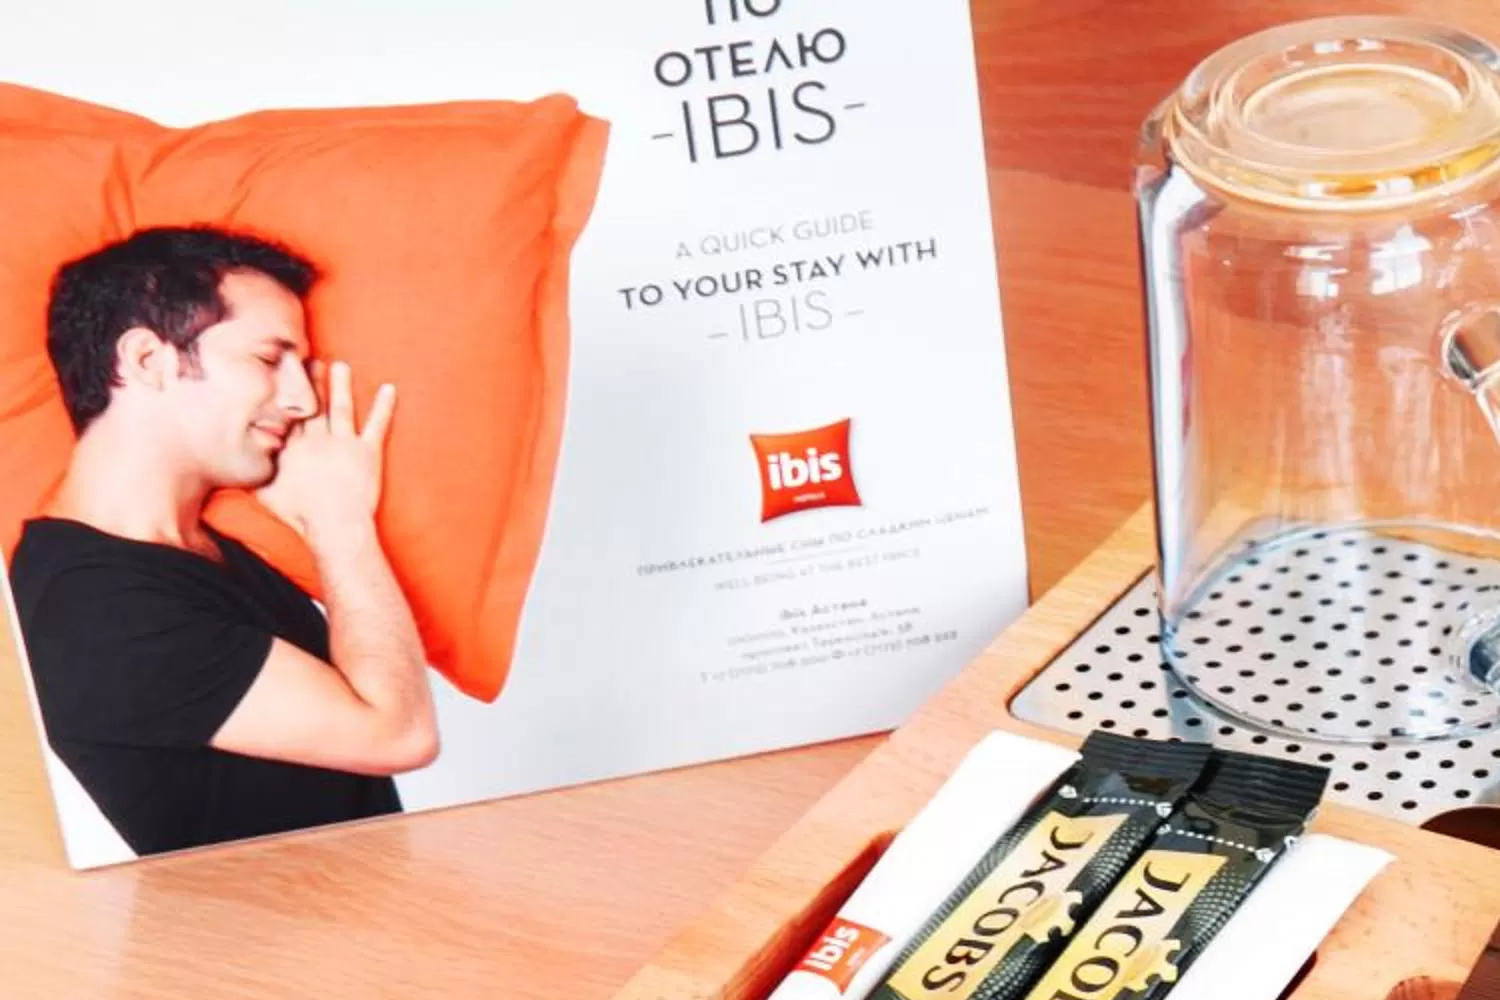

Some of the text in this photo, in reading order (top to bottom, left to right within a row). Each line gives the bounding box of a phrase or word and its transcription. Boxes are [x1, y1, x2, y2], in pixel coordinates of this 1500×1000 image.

[654, 28, 847, 87] ОТЕЛЮ
[675, 210, 876, 260] A QUICK GUIDE
[618, 238, 938, 310] TO YOUR STAY WITH
[767, 447, 843, 491] ibis
[921, 825, 1094, 994] JACOBS
